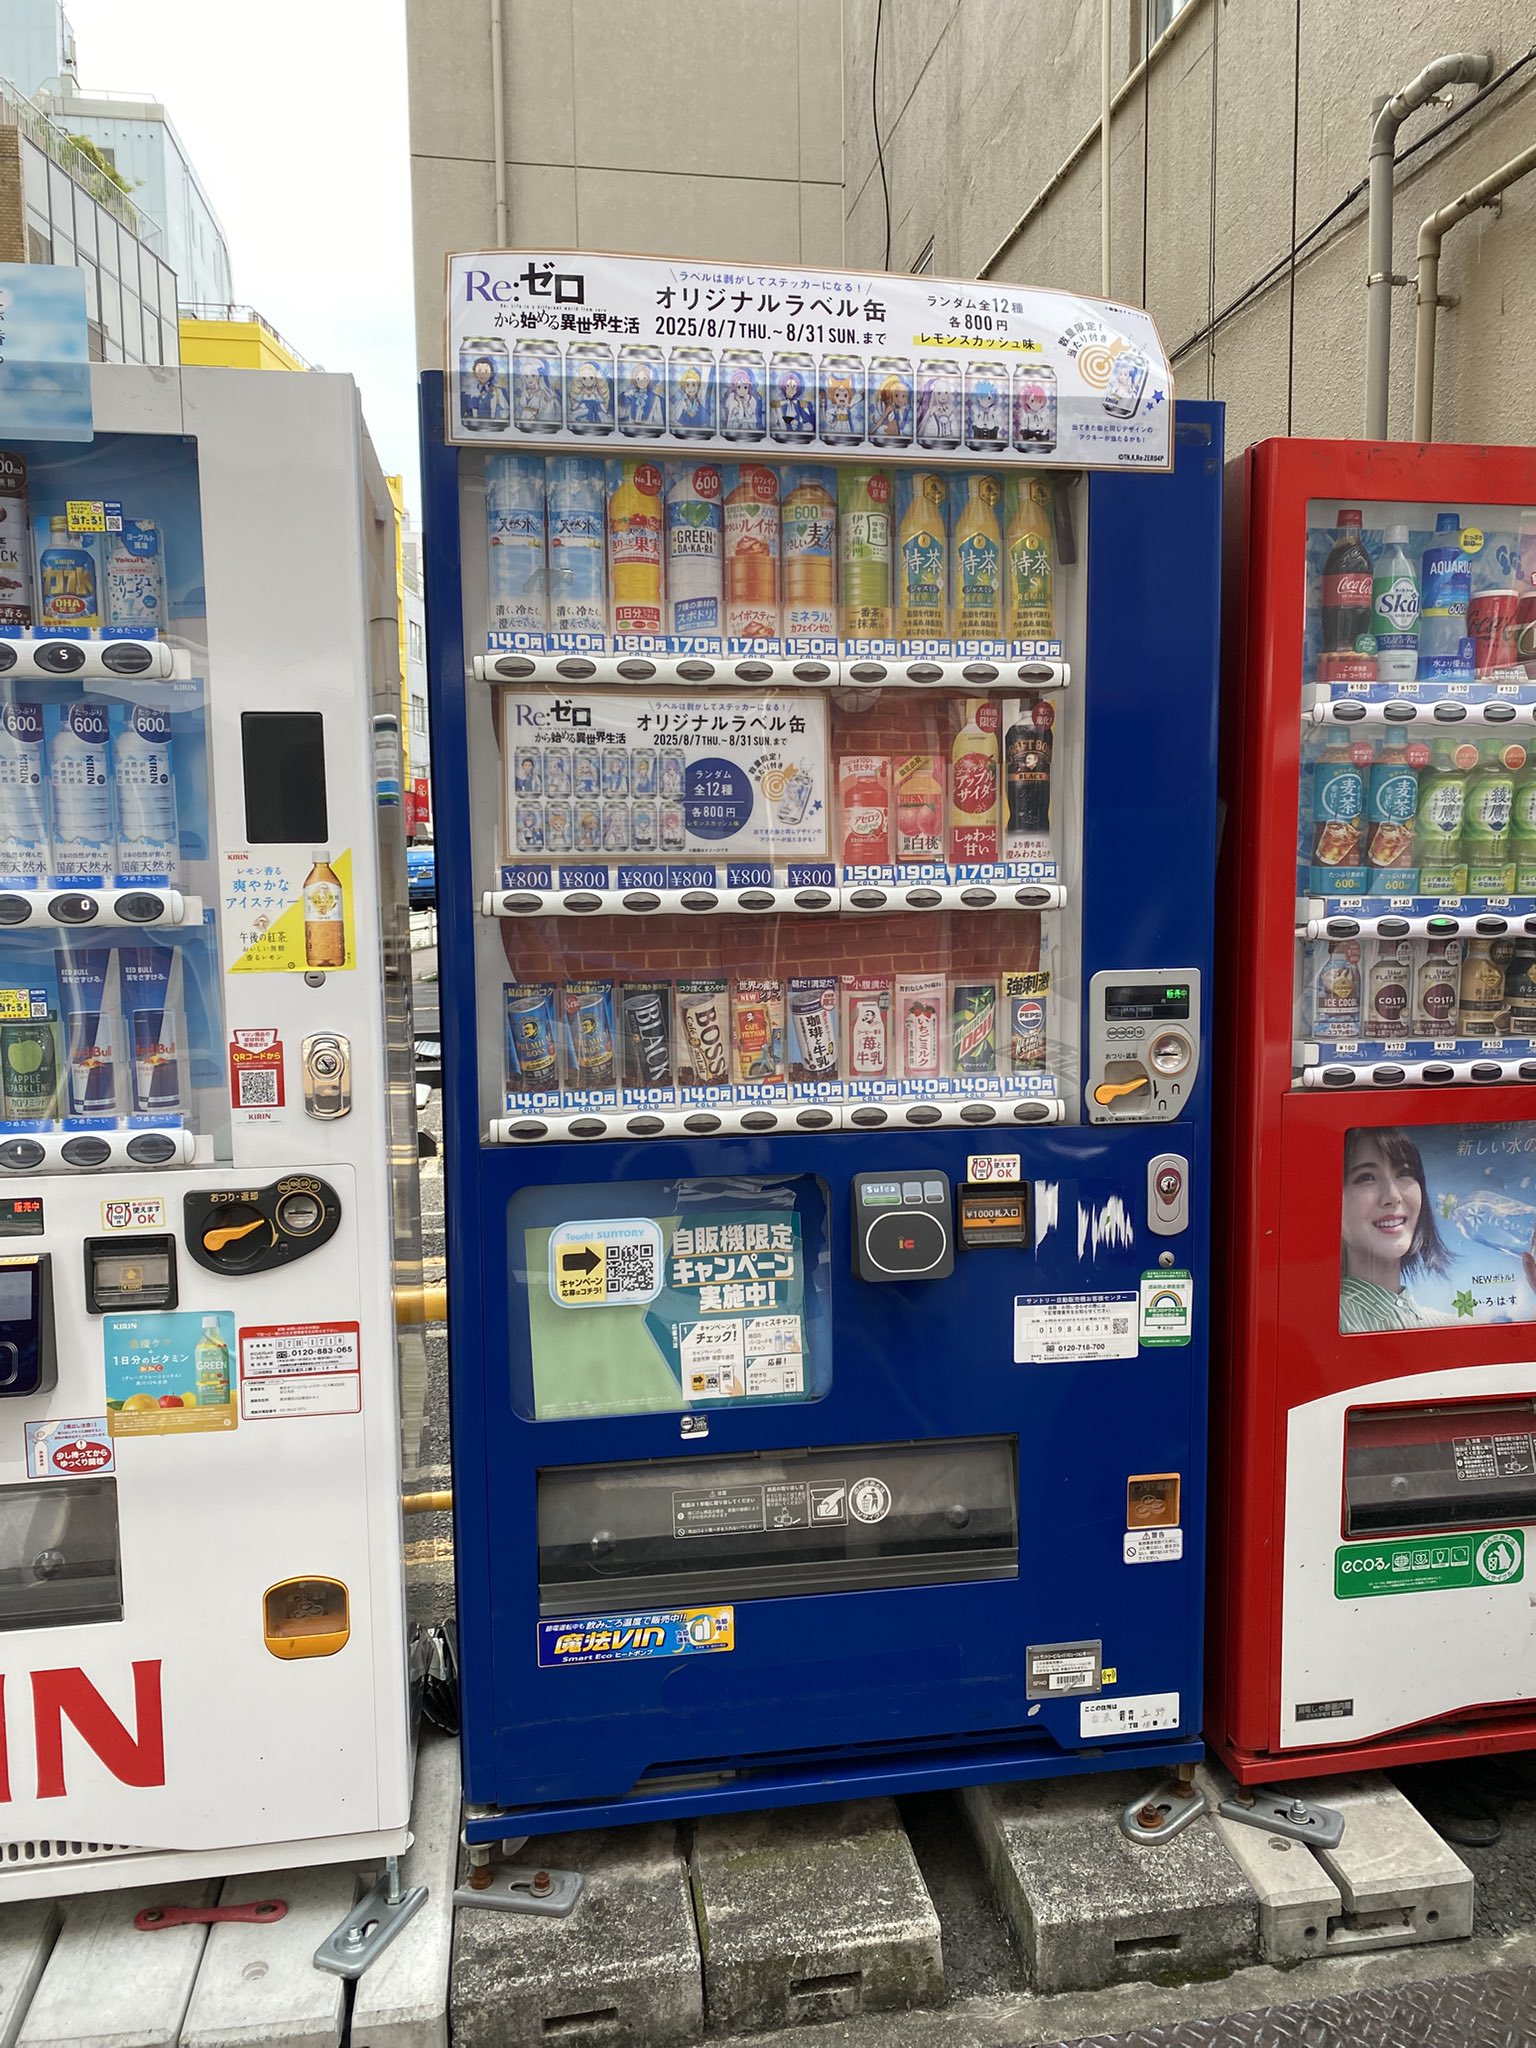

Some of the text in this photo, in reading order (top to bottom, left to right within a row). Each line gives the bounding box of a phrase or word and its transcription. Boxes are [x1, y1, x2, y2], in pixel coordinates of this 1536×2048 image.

[464, 261, 585, 305] Re:ゼロ
[679, 271, 862, 293] ラベルは剥がしてステッカーになる!
[656, 286, 887, 322] オリジナルラベル缶
[927, 296, 1024, 315] ランダム全12種
[494, 309, 640, 335] から始める異世界生活
[948, 313, 1008, 332] 各800円
[919, 332, 1036, 351] レモンスカッシュ味
[1067, 332, 1107, 359] 当たり付き
[71, 515, 102, 525] 当たる!
[794, 505, 819, 520] 600
[126, 533, 156, 542] ヨーグルト
[677, 530, 713, 544] GREEN
[902, 548, 943, 575] 特茶
[958, 549, 998, 576] 特茶
[1011, 550, 1052, 577] 特茶
[1430, 560, 1472, 575] AQUARIU
[55, 599, 81, 608] DHA
[677, 608, 716, 624] スポドリ!
[730, 611, 776, 621] ルイボスティー
[489, 633, 542, 649] 140円
[550, 633, 603, 650] 140円
[615, 635, 667, 651] 180円
[671, 638, 722, 653] 170円
[731, 638, 782, 654] 170円
[787, 638, 838, 654] 150円
[846, 640, 896, 655] 160円
[901, 640, 950, 655] 190円
[957, 640, 1006, 656] 190円
[1013, 641, 1062, 656] 190円
[1432, 659, 1471, 669] 水より優れた
[514, 699, 592, 727] Re:ゼロ
[7, 717, 36, 732] 600
[74, 717, 103, 733] 600
[137, 717, 165, 733] 600
[637, 714, 806, 734] オリジナルラベル缶
[534, 731, 627, 745] から始める異世界生活
[19, 754, 29, 784] KIRIN
[86, 755, 95, 785] KIRIN
[149, 754, 159, 784] KIRIN
[695, 770, 732, 779] ランダム
[956, 769, 995, 789] アップル
[693, 782, 733, 796] 全12種
[957, 784, 997, 803] サイダー
[1340, 778, 1357, 814] 麦茶
[1394, 779, 1412, 816] 麦茶
[1440, 786, 1457, 821] 綾鷹
[1489, 786, 1507, 822] 綾鷹
[691, 806, 736, 818] 各800円
[911, 835, 939, 850] 白桃
[954, 829, 996, 843] しゅわっと
[963, 843, 990, 857] 甘い
[56, 861, 113, 874] 国産天然水
[121, 860, 176, 873] 国産天然水
[236, 866, 281, 876] レモン香る
[845, 866, 895, 879] 150円
[898, 864, 945, 878] 190円
[959, 864, 1005, 878] 170円
[1008, 862, 1055, 877] 180円
[504, 871, 549, 888] ¥800
[562, 871, 605, 888] ¥800
[621, 871, 664, 888] ¥800
[671, 871, 713, 887] ¥800
[729, 868, 771, 885] ¥800
[790, 870, 833, 887] ¥800
[232, 878, 289, 892] 爽やかな
[225, 897, 299, 909] アイスティー
[240, 931, 287, 944] 午後の紅茶
[125, 966, 137, 974] RED
[739, 981, 779, 990] 世界の産地
[853, 980, 891, 990] 小腹満たし
[1006, 971, 1050, 997] 強刺激
[739, 993, 758, 1001] NEW
[1166, 988, 1188, 999] 販売中
[1427, 996, 1454, 1004] COSTA
[635, 1002, 670, 1081] BLACK
[695, 1005, 726, 1075] BOSS
[805, 1015, 830, 1068] 珈琲と牛乳
[863, 1036, 881, 1050] 苺と
[917, 1018, 929, 1067] いちごミルク
[233, 1052, 281, 1062] QRコードから
[856, 1051, 883, 1066] 牛乳
[13, 1074, 41, 1084] APPLE
[902, 1079, 949, 1094] 140円
[953, 1078, 1000, 1093] 140円
[1005, 1076, 1054, 1091] 140円
[682, 1086, 731, 1101] 140円
[737, 1084, 787, 1099] 140円
[794, 1082, 843, 1097] 140円
[850, 1080, 898, 1095] 140円
[12, 1098, 46, 1107] カロリミット
[508, 1093, 560, 1108] 140円
[564, 1090, 616, 1106] 140円
[624, 1088, 673, 1104] 140円
[1456, 1136, 1536, 1157] 新しい水の
[997, 1169, 1012, 1178] OK
[210, 1191, 259, 1202] おつり・返却
[866, 1185, 896, 1194] Suica
[14, 1201, 40, 1213] 販売中
[966, 1208, 1019, 1218] ¥1000札入口
[137, 1214, 156, 1224] OK
[672, 1223, 794, 1256] 自販機限定
[672, 1254, 795, 1285] キャンペーン
[560, 1278, 603, 1289] キャンペーン
[1472, 1274, 1515, 1285] NEWボトル!
[562, 1287, 602, 1298] 応募はコチラ!
[699, 1282, 777, 1311] 実施中!
[113, 1322, 138, 1330] KIRIN
[700, 1323, 737, 1331] キャンペーンを
[755, 1318, 797, 1328] 買ってスキャン!
[696, 1330, 737, 1345] チェック!
[1058, 1343, 1105, 1352] 0120-718-700
[112, 1354, 189, 1366] 1日分のビタミン
[196, 1360, 228, 1370] GREEN
[56, 1449, 107, 1461] 少し待ってから
[59, 1458, 105, 1468] ゆっくり開栓
[1485, 1570, 1514, 1581] リサイクル
[615, 1649, 653, 1658] ヒートポンプ
[1084, 1704, 1118, 1713] ここの住所は
